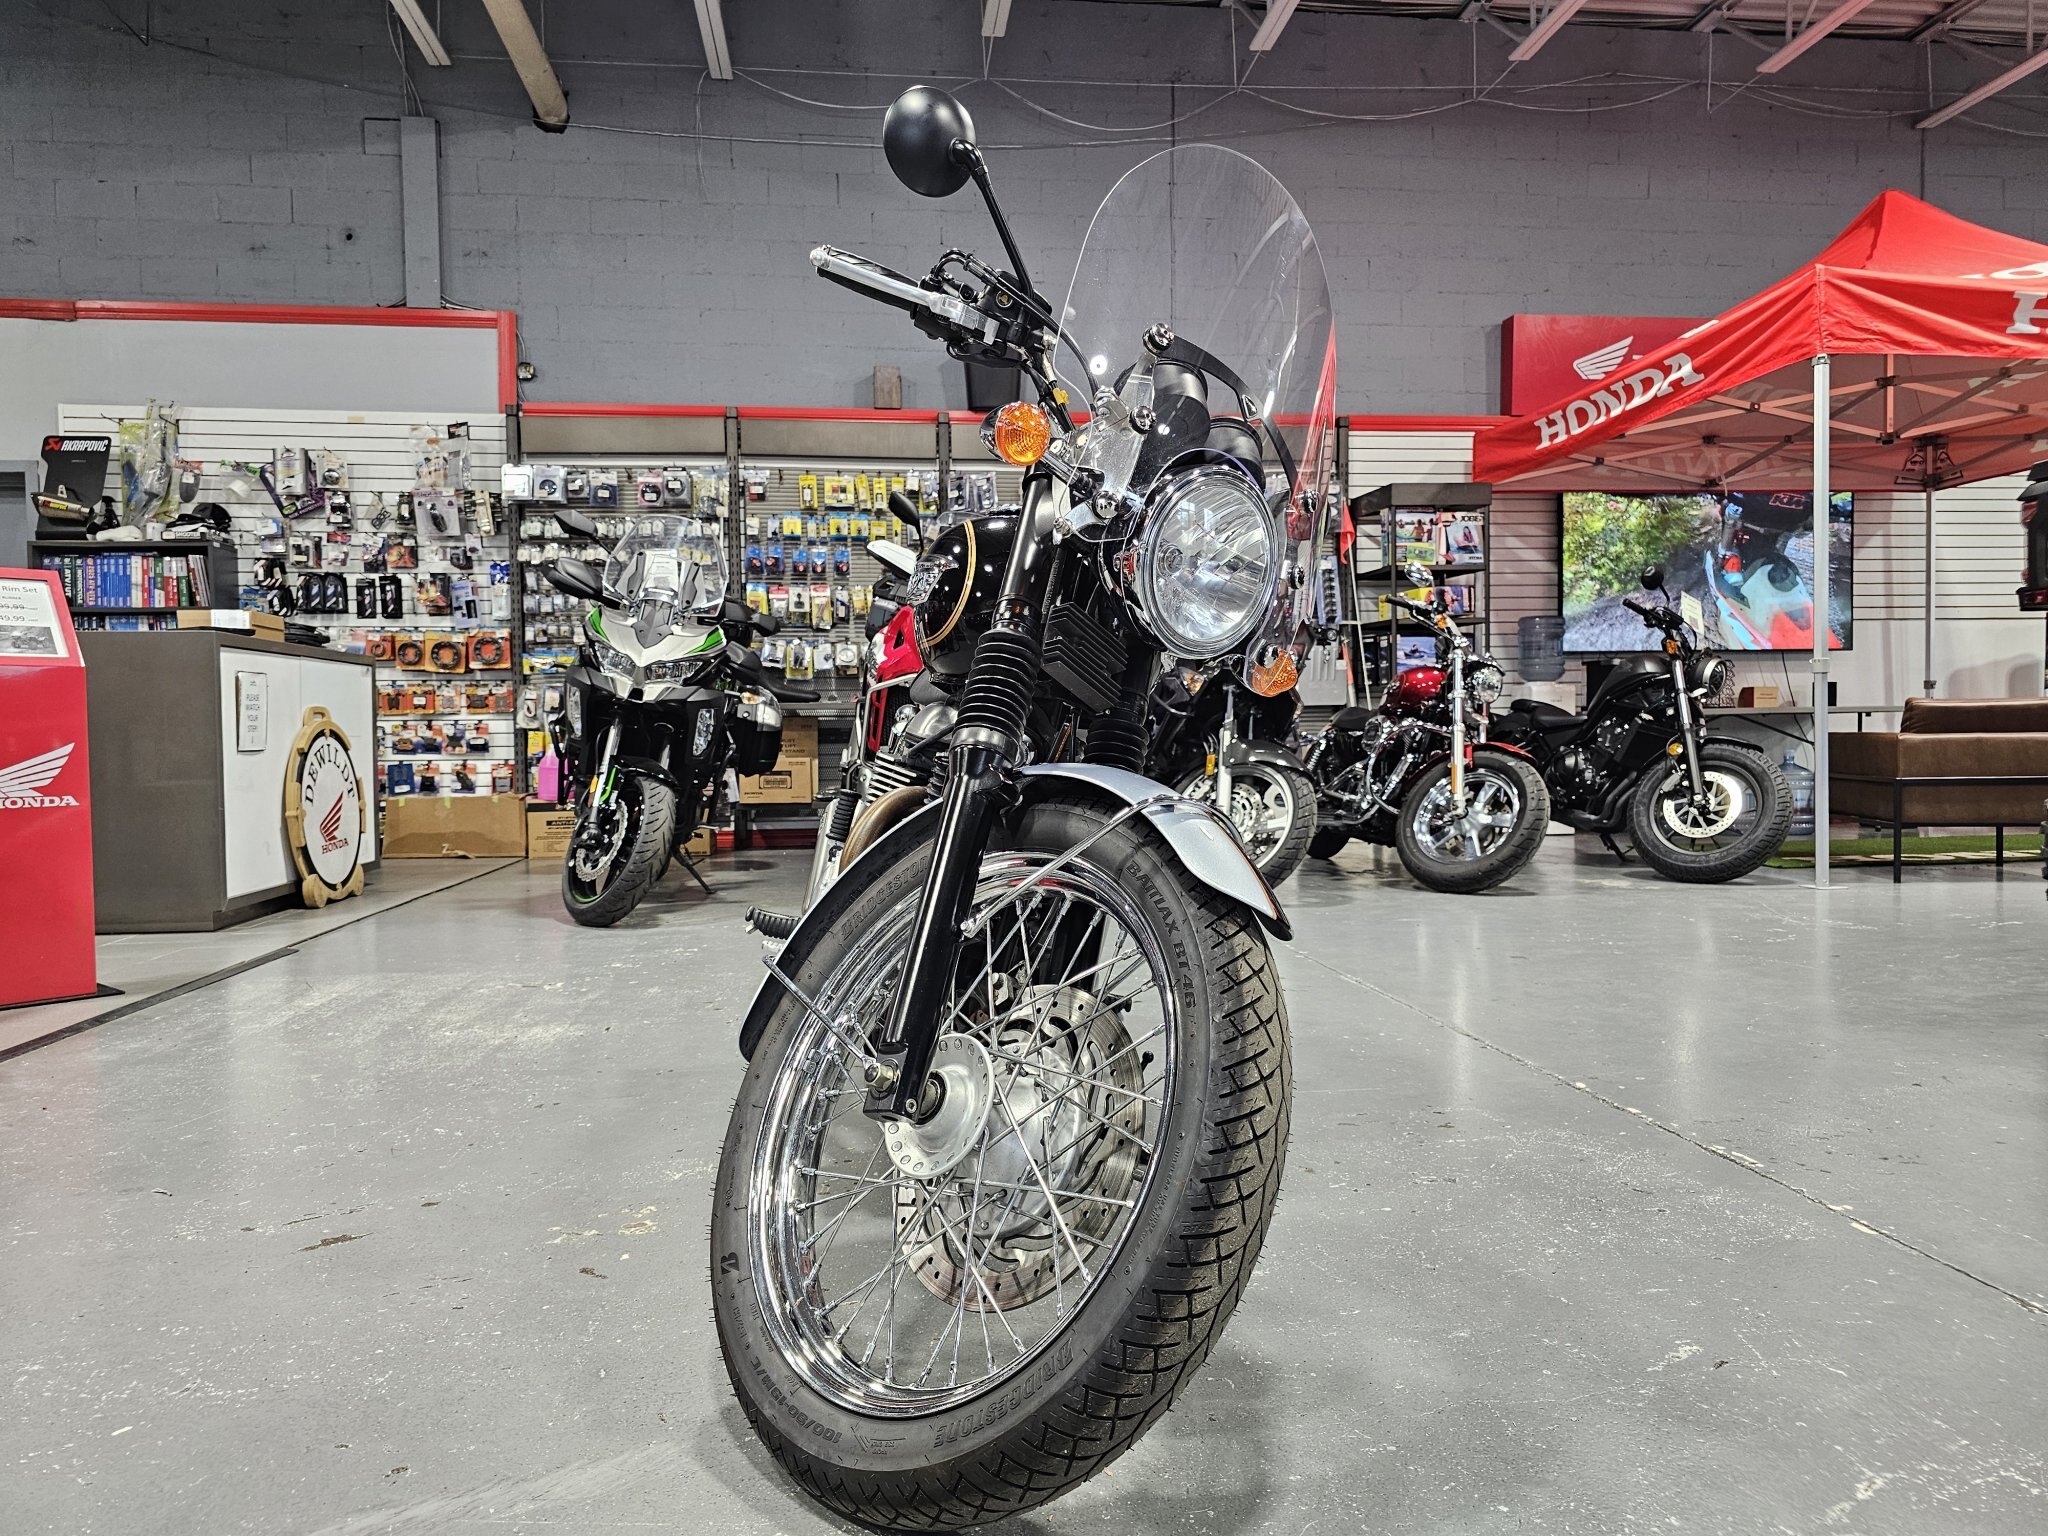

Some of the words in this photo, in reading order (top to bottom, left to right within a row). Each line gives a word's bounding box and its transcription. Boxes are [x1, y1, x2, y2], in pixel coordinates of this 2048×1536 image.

[1534, 352, 1704, 450] HONDA
[64, 568, 72, 598] ATV/UT
[305, 744, 355, 806] DEWILDT
[321, 838, 349, 854] HONDA
[841, 855, 929, 940] BRIDGESTON
[1126, 860, 1180, 937] BATTLAX
[934, 1338, 1073, 1448] BRIDGESTONE
